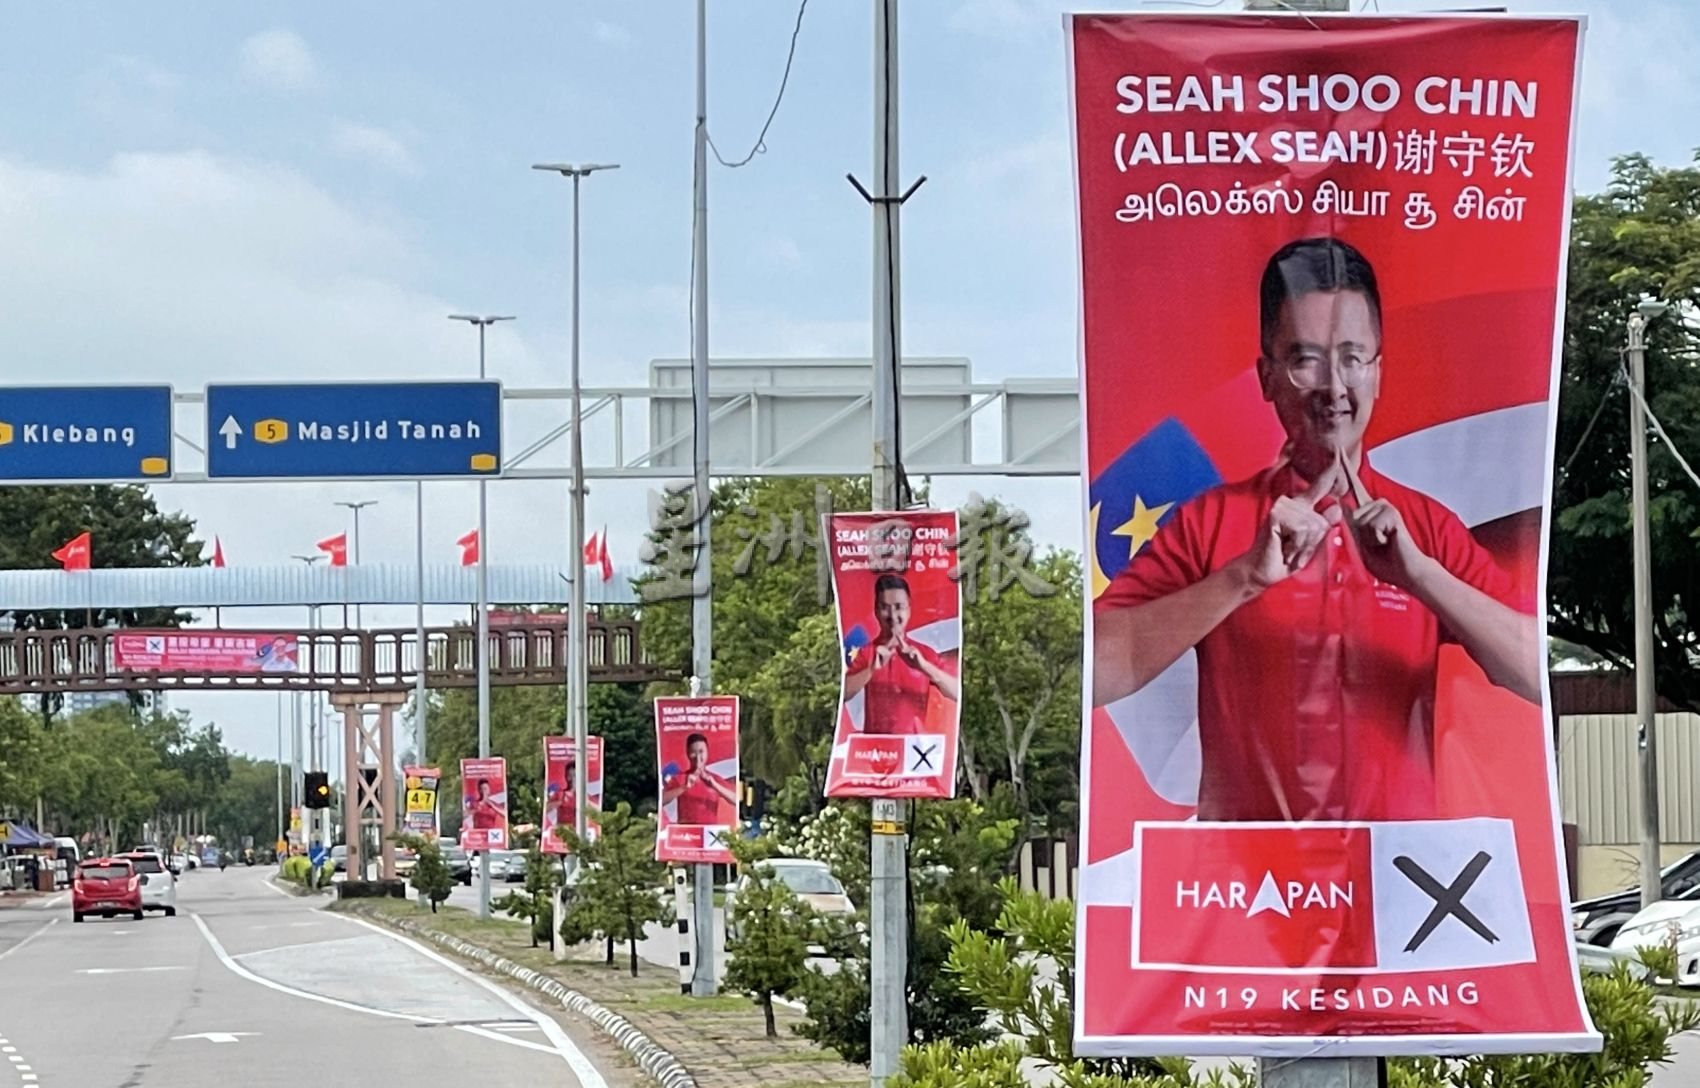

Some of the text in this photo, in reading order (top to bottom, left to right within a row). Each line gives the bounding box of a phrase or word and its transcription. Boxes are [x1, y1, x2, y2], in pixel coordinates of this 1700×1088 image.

[1116, 73, 1538, 118] SEAH SHOO CHIN
[1114, 128, 1534, 178] (ALLEX SEAH) 谢守钦
[1115, 179, 1303, 223] அலெக்ஸ்
[1312, 180, 1391, 217] சியா
[1453, 186, 1527, 222] சின்
[23, 424, 134, 447] Klebang
[266, 419, 481, 442] 5 Masjid Tanah
[915, 527, 949, 540] CHIN
[1176, 870, 1353, 919] HARAPAN
[1184, 981, 1479, 1011] N19 KESIDANG
